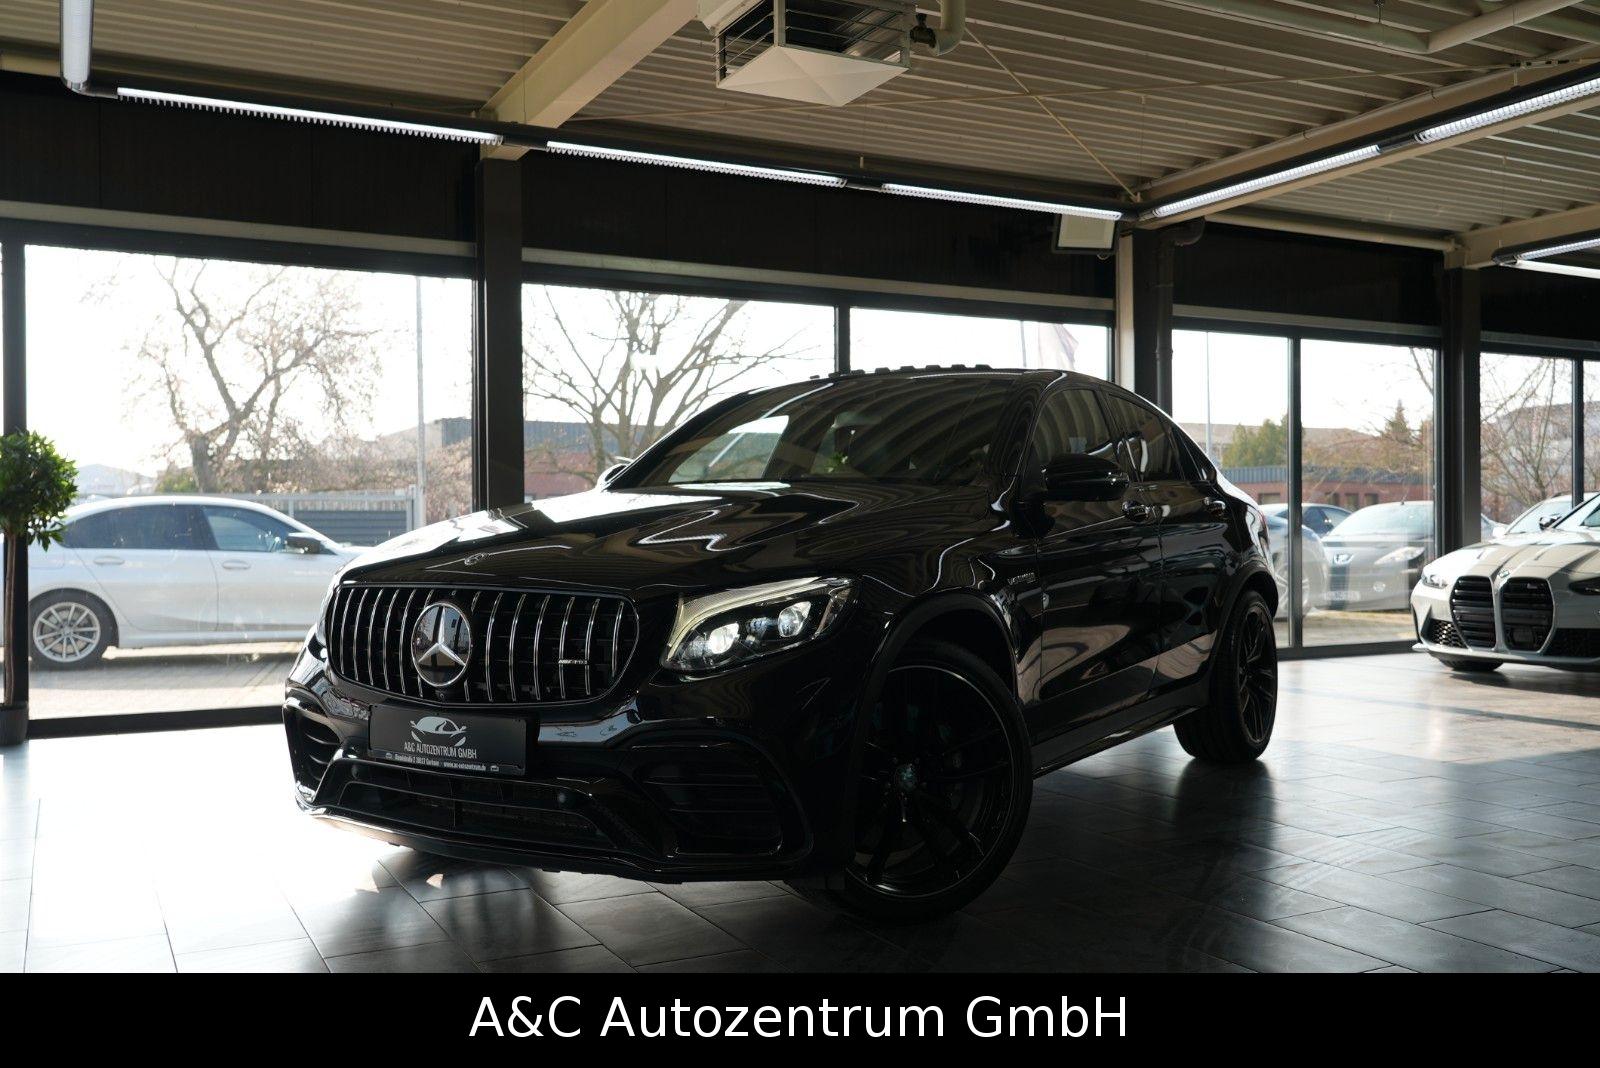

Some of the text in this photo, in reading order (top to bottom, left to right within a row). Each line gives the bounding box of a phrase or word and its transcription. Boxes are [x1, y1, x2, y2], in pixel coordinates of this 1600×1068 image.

[403, 741, 416, 753] A&C
[416, 743, 457, 758] AUTOZENTRUM
[458, 747, 477, 759] GMBH
